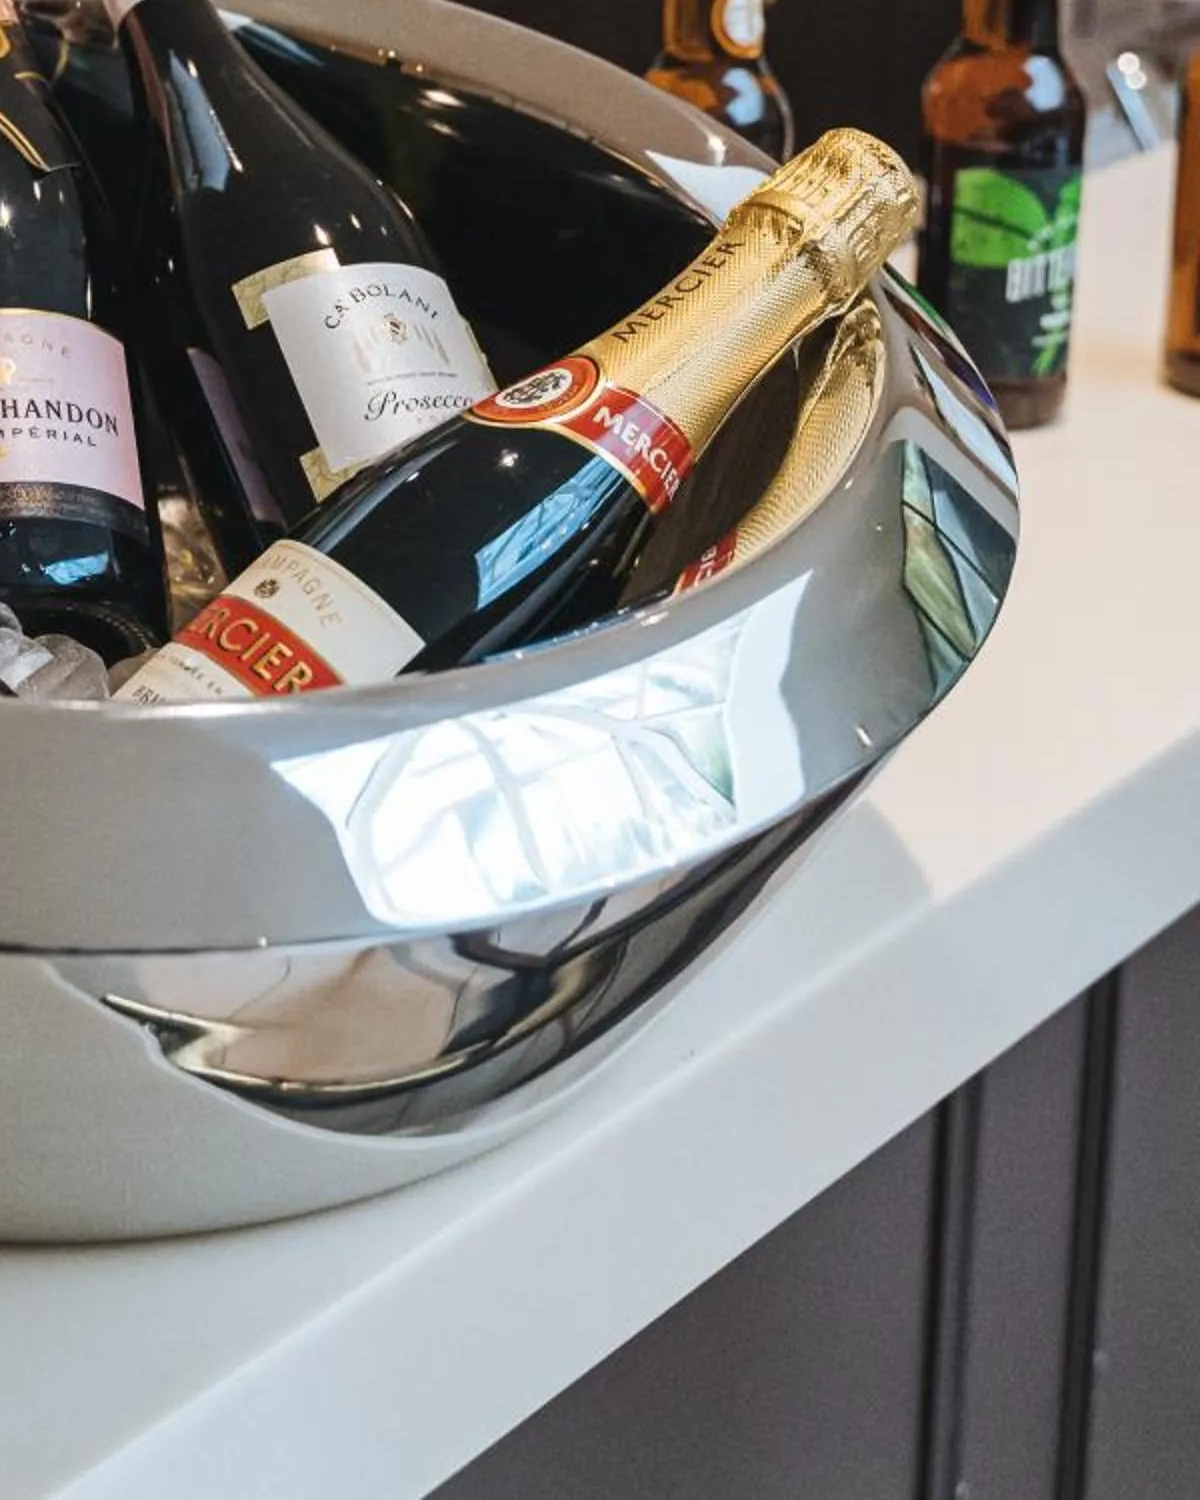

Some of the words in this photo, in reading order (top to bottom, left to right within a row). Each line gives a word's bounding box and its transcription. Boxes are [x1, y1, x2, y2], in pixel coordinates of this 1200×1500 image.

[349, 282, 439, 323] BOLANI
[610, 239, 744, 343] MERCIER
[592, 404, 681, 503] MERCIER
[190, 606, 314, 694] RCIER
